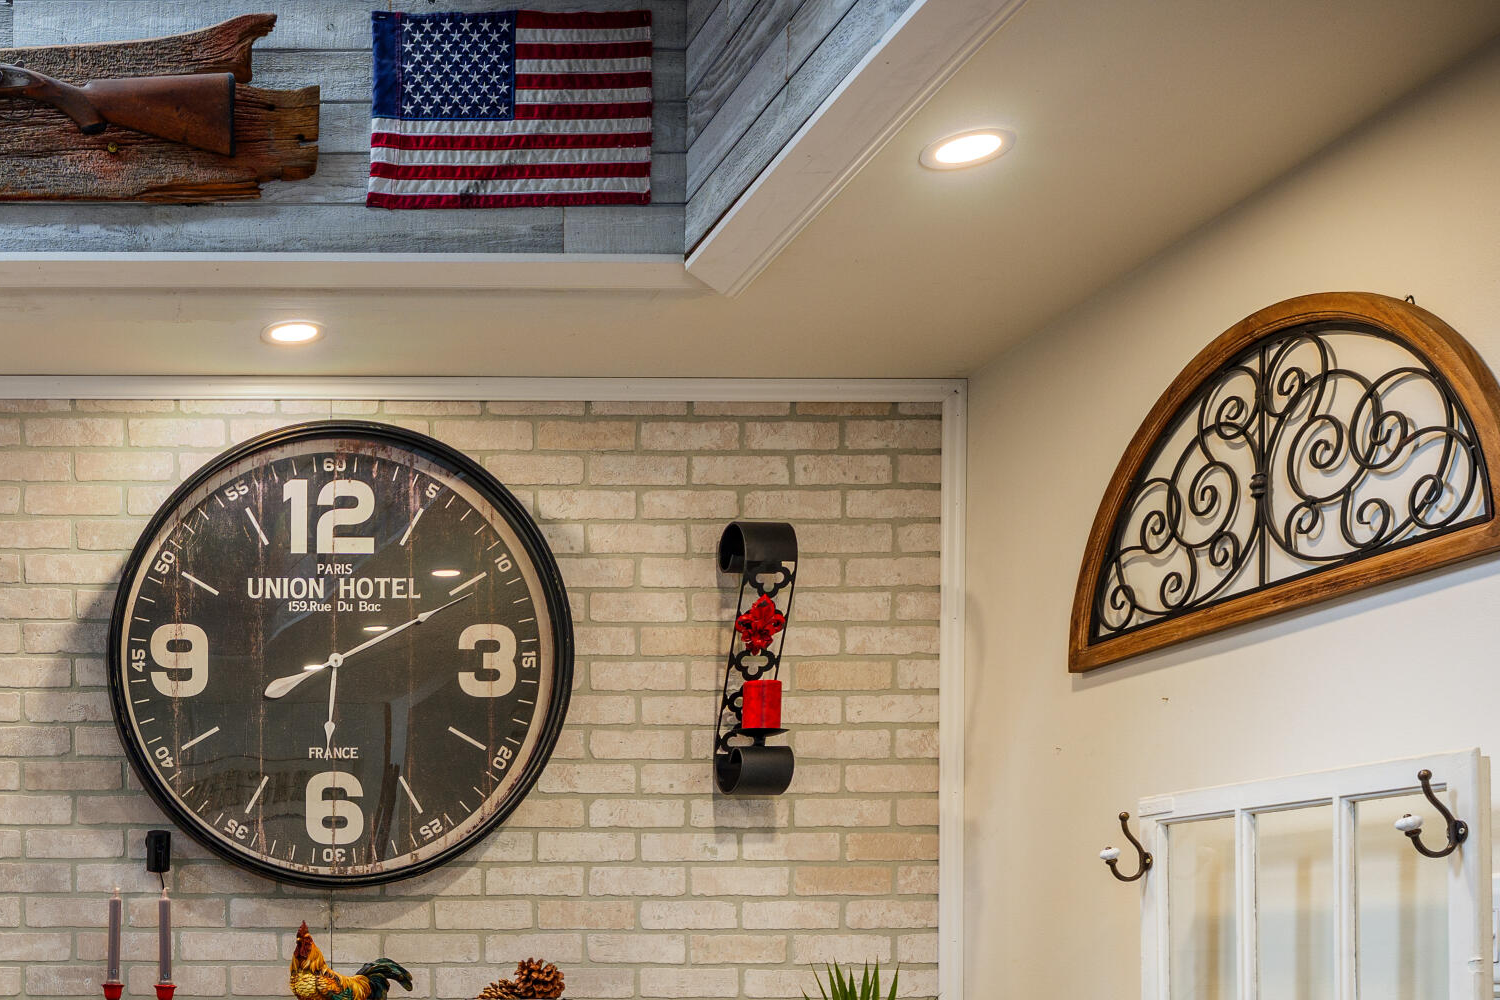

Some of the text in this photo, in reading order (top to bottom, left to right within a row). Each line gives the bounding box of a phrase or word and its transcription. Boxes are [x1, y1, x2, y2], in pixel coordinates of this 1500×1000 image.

[323, 458, 347, 472] 60
[225, 480, 250, 502] 55
[425, 484, 440, 499] 5
[282, 478, 375, 554] 12
[156, 551, 176, 576] 50
[317, 563, 353, 575] PARIS
[493, 553, 513, 573] 10
[247, 577, 421, 599] UNION HOTEL
[337, 601, 353, 612] Du
[359, 601, 381, 612] Bac
[132, 649, 147, 673] 45
[150, 623, 209, 698] 9
[457, 623, 517, 698] 3
[521, 651, 536, 668] 15
[154, 745, 175, 769] 40
[308, 747, 359, 759] FRANCE
[492, 745, 513, 770] 20
[305, 771, 364, 845] 6
[223, 819, 249, 840] 35
[419, 819, 445, 839] 25
[322, 848, 346, 862] 30
